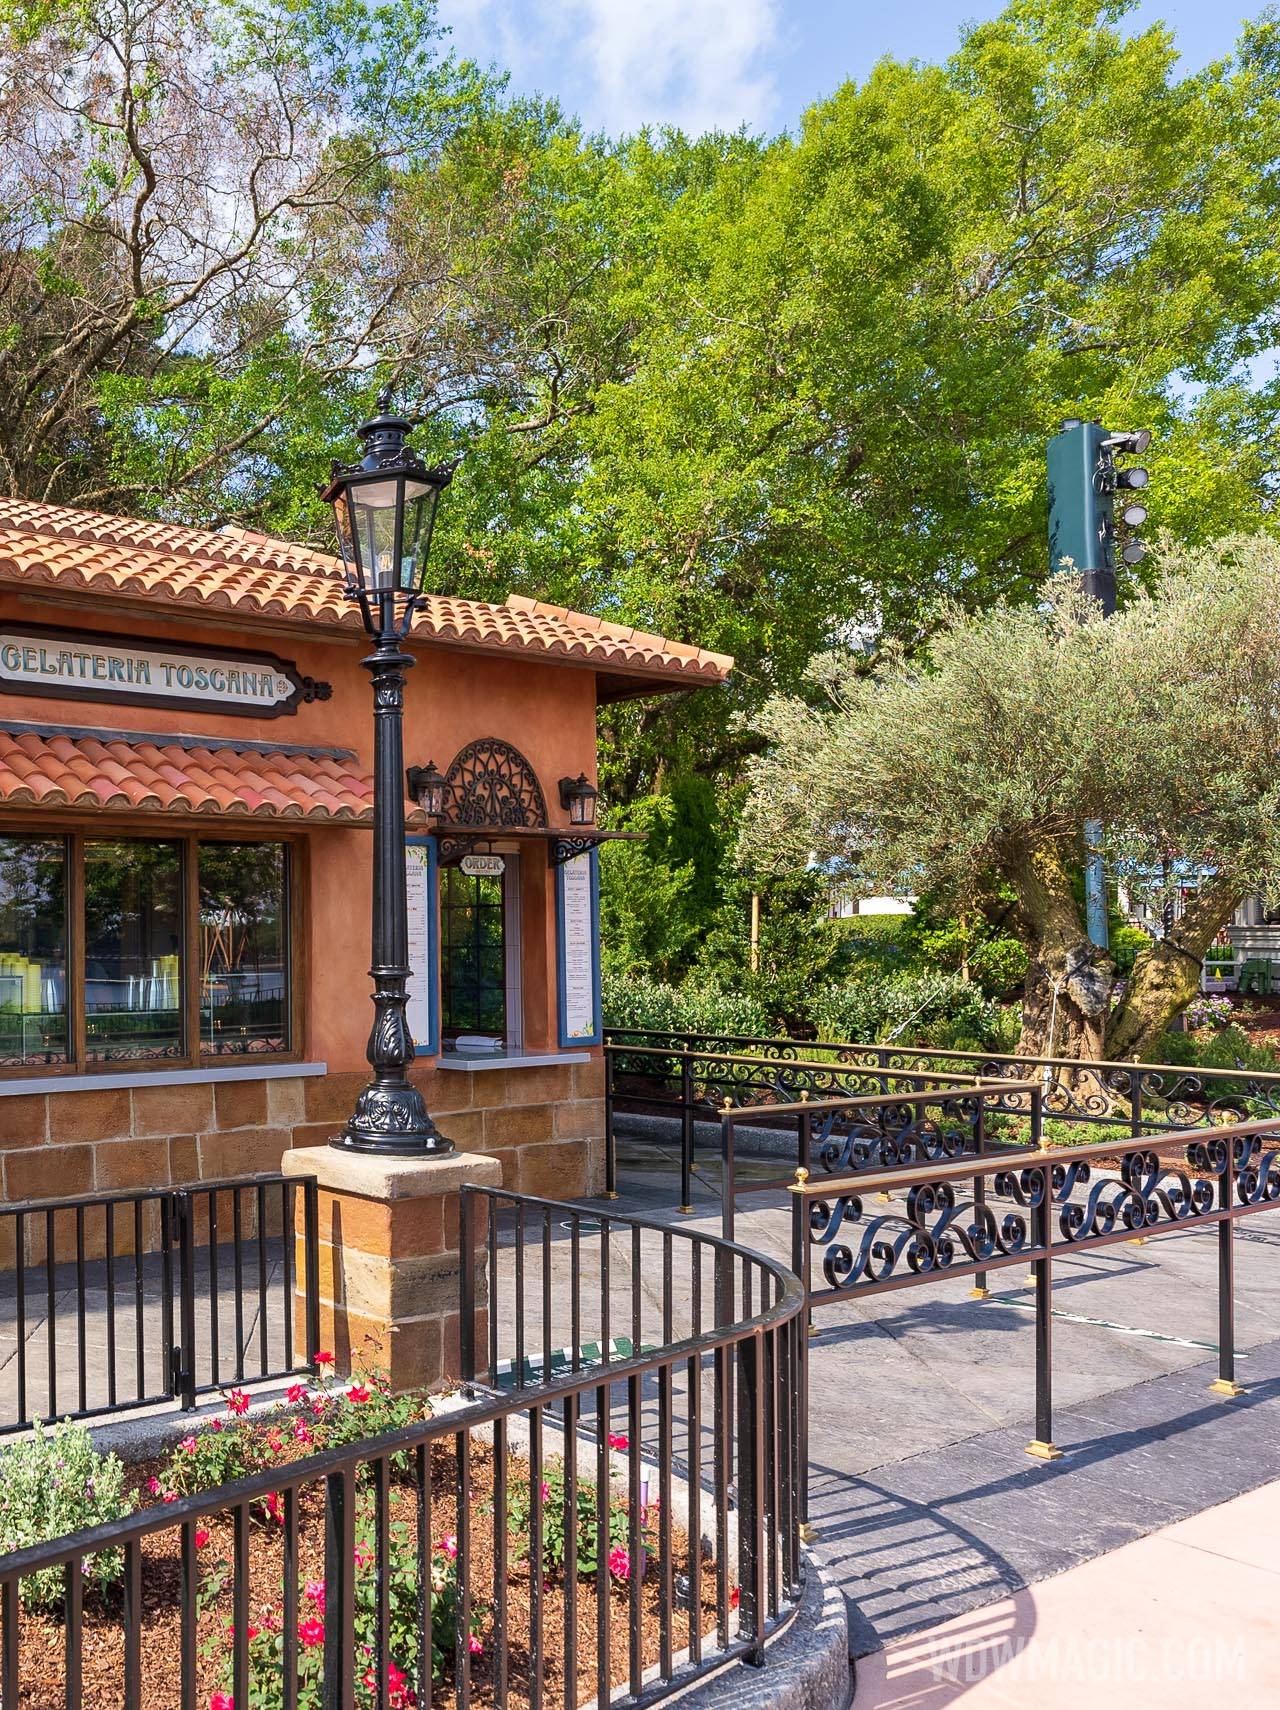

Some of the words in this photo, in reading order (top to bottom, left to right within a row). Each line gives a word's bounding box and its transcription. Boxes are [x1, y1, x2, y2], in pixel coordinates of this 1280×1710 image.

[0, 643, 152, 685] GELATERIA
[160, 662, 276, 698] TOSCANA
[464, 857, 501, 870] ORDER
